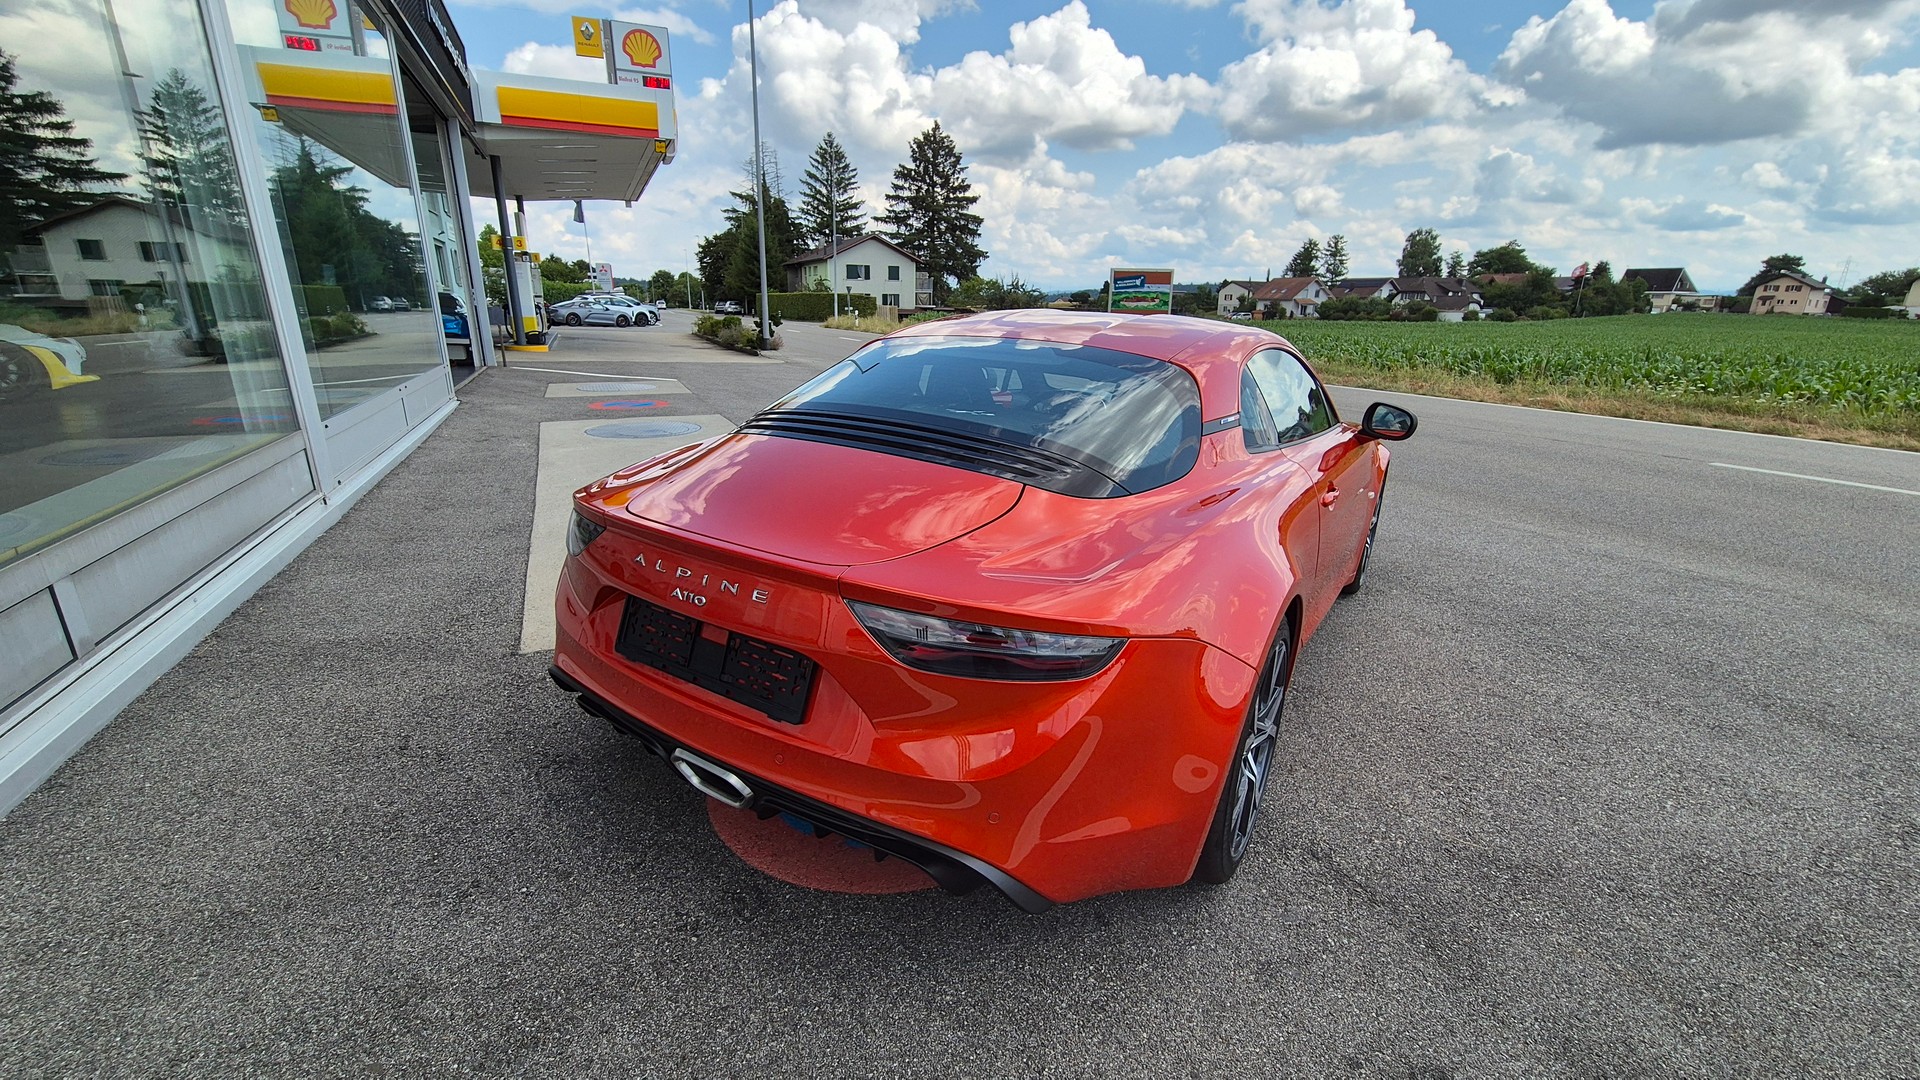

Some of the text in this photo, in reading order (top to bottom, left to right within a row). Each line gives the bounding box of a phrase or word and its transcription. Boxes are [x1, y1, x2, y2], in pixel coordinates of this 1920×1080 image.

[516, 239, 523, 248] 3
[634, 553, 769, 604] ALPINE
[671, 587, 707, 606] A110
